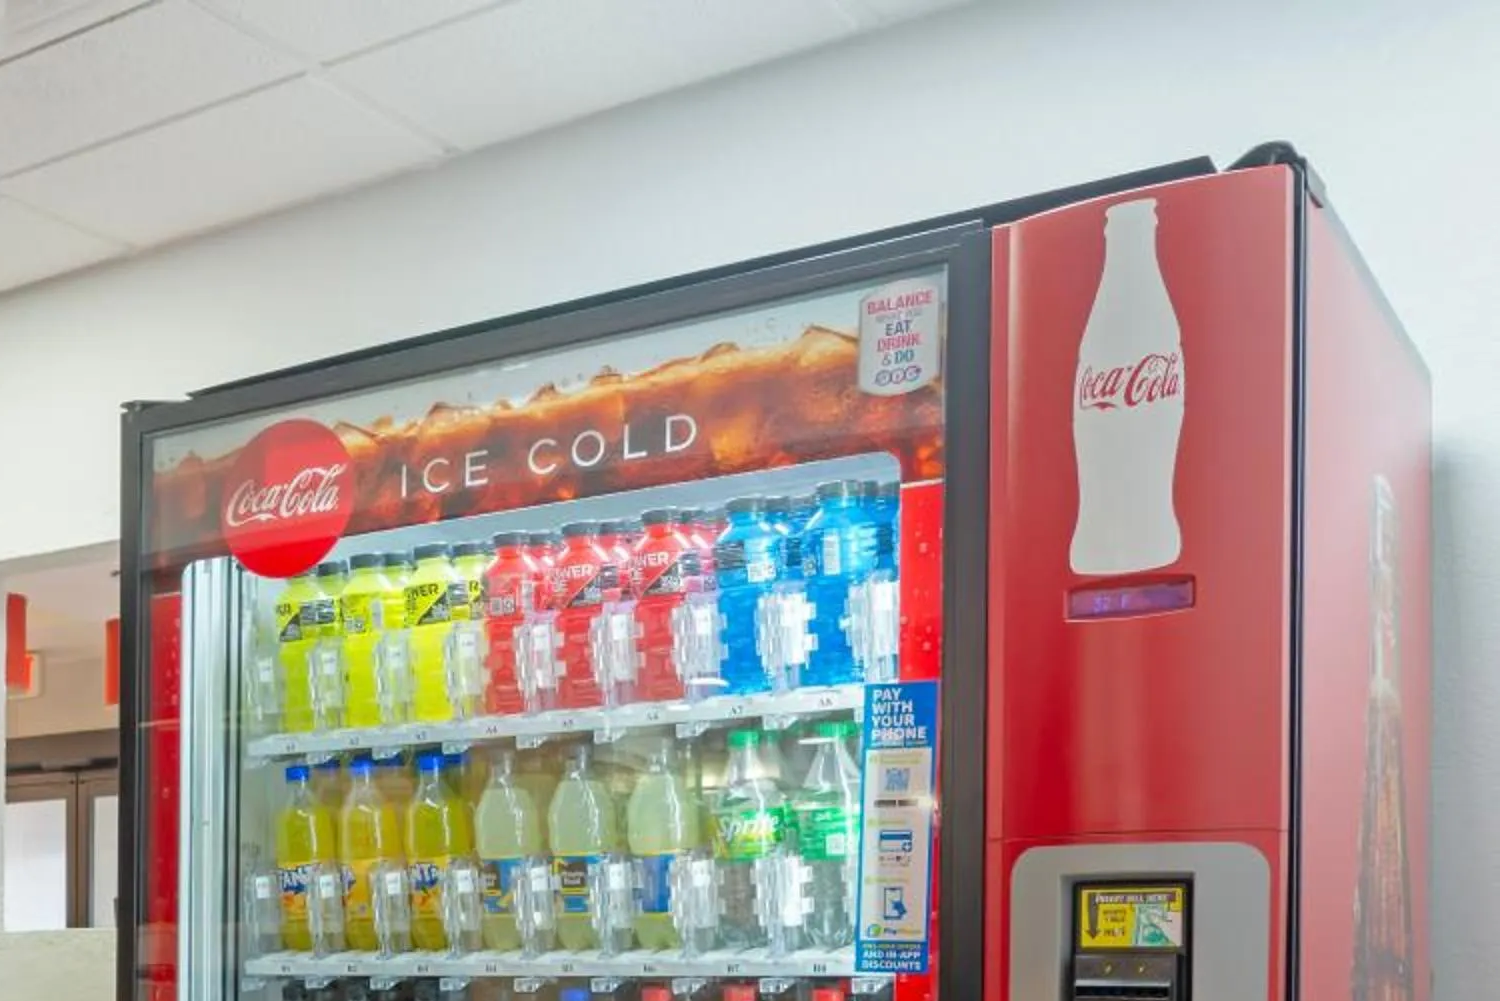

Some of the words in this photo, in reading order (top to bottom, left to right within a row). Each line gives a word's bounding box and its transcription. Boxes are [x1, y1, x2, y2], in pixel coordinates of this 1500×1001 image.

[867, 289, 933, 315] BALANCE
[877, 333, 921, 352] DRINK
[894, 349, 915, 364] DO
[401, 450, 489, 499] ICE
[526, 414, 699, 476] COLD
[226, 463, 348, 527] Coca-Cola
[873, 687, 902, 701] PAY
[872, 700, 913, 715] WITH
[871, 713, 916, 727] YOUR
[871, 726, 928, 741] PHONE
[860, 959, 922, 972] DISCOUNTS
